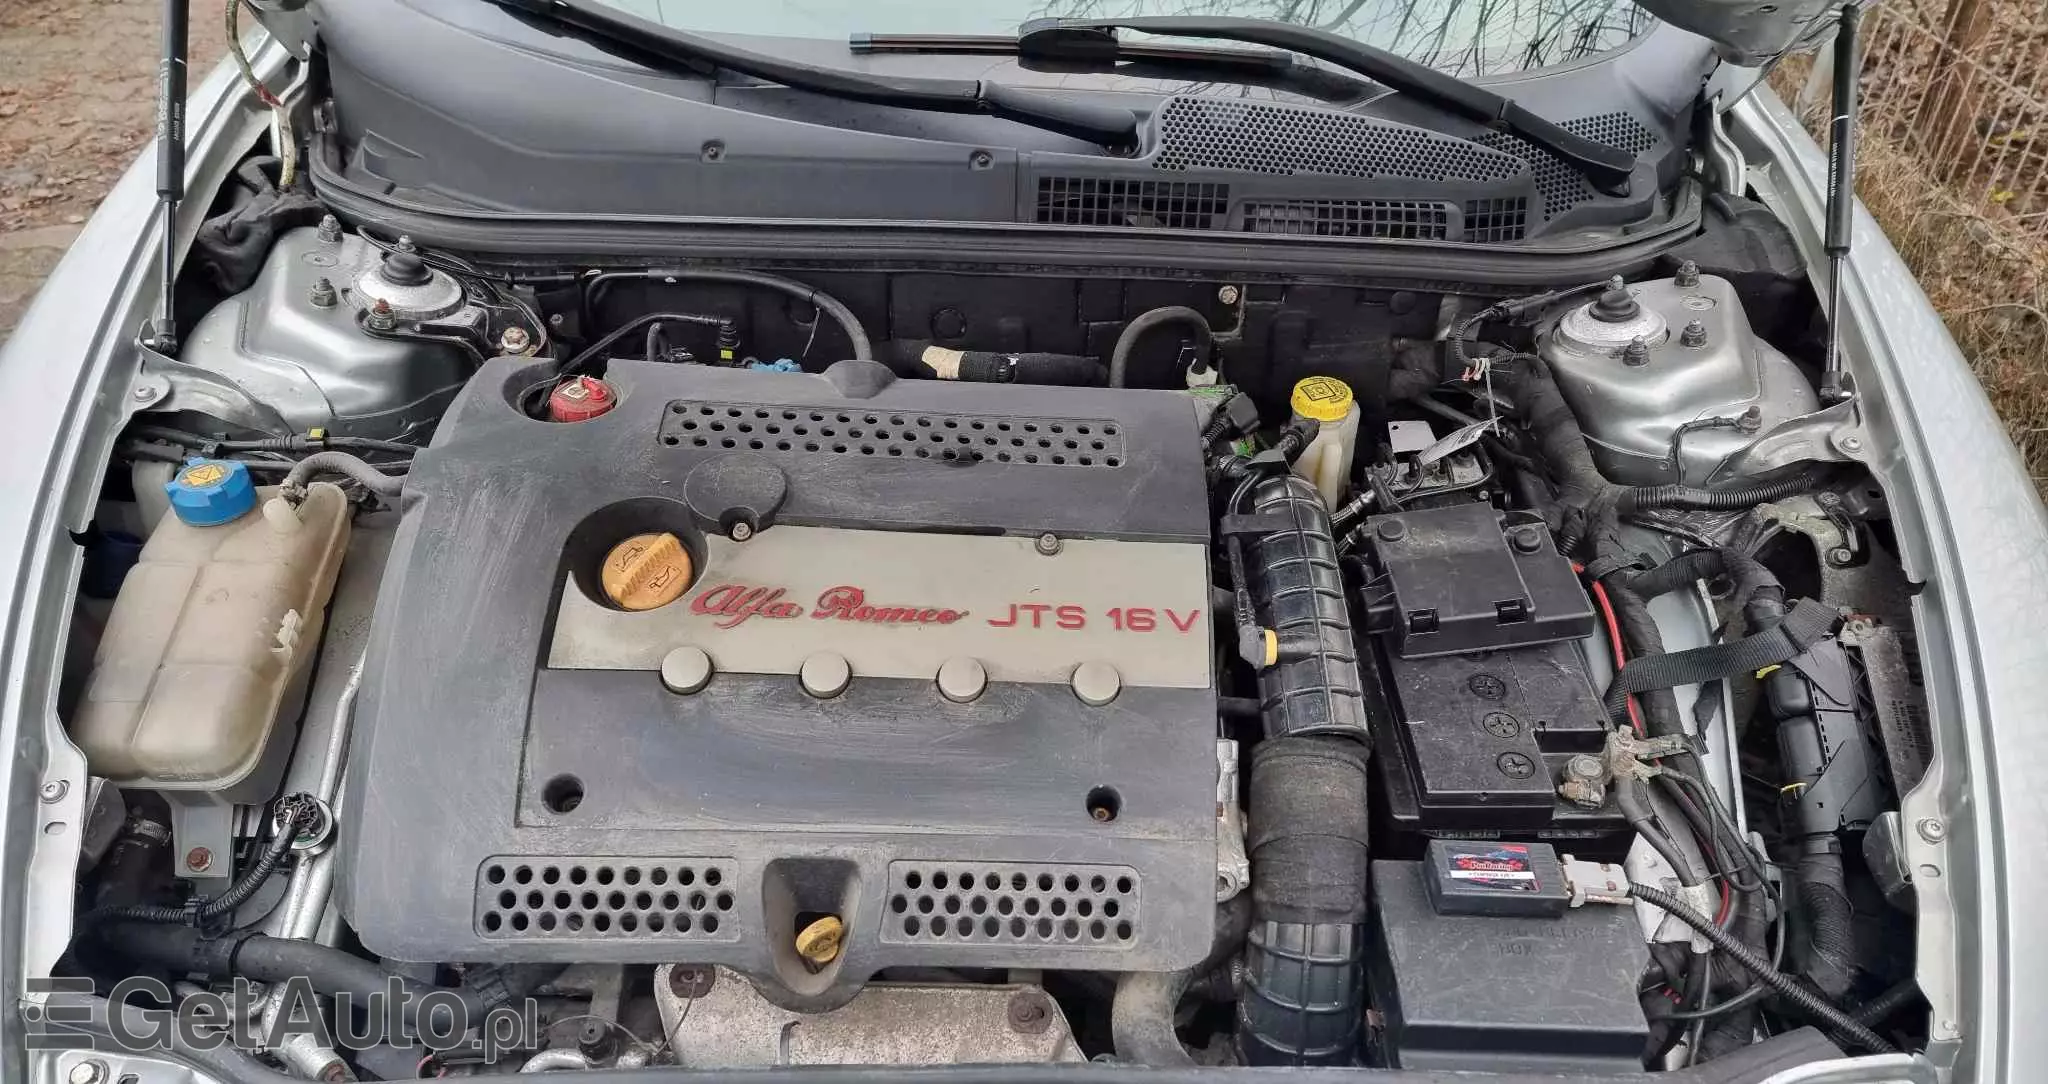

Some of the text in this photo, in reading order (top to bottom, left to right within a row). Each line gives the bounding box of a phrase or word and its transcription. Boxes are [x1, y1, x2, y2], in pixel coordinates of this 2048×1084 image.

[689, 584, 803, 630] Alfa
[810, 585, 970, 625] Romeo
[987, 604, 1086, 631] JTS
